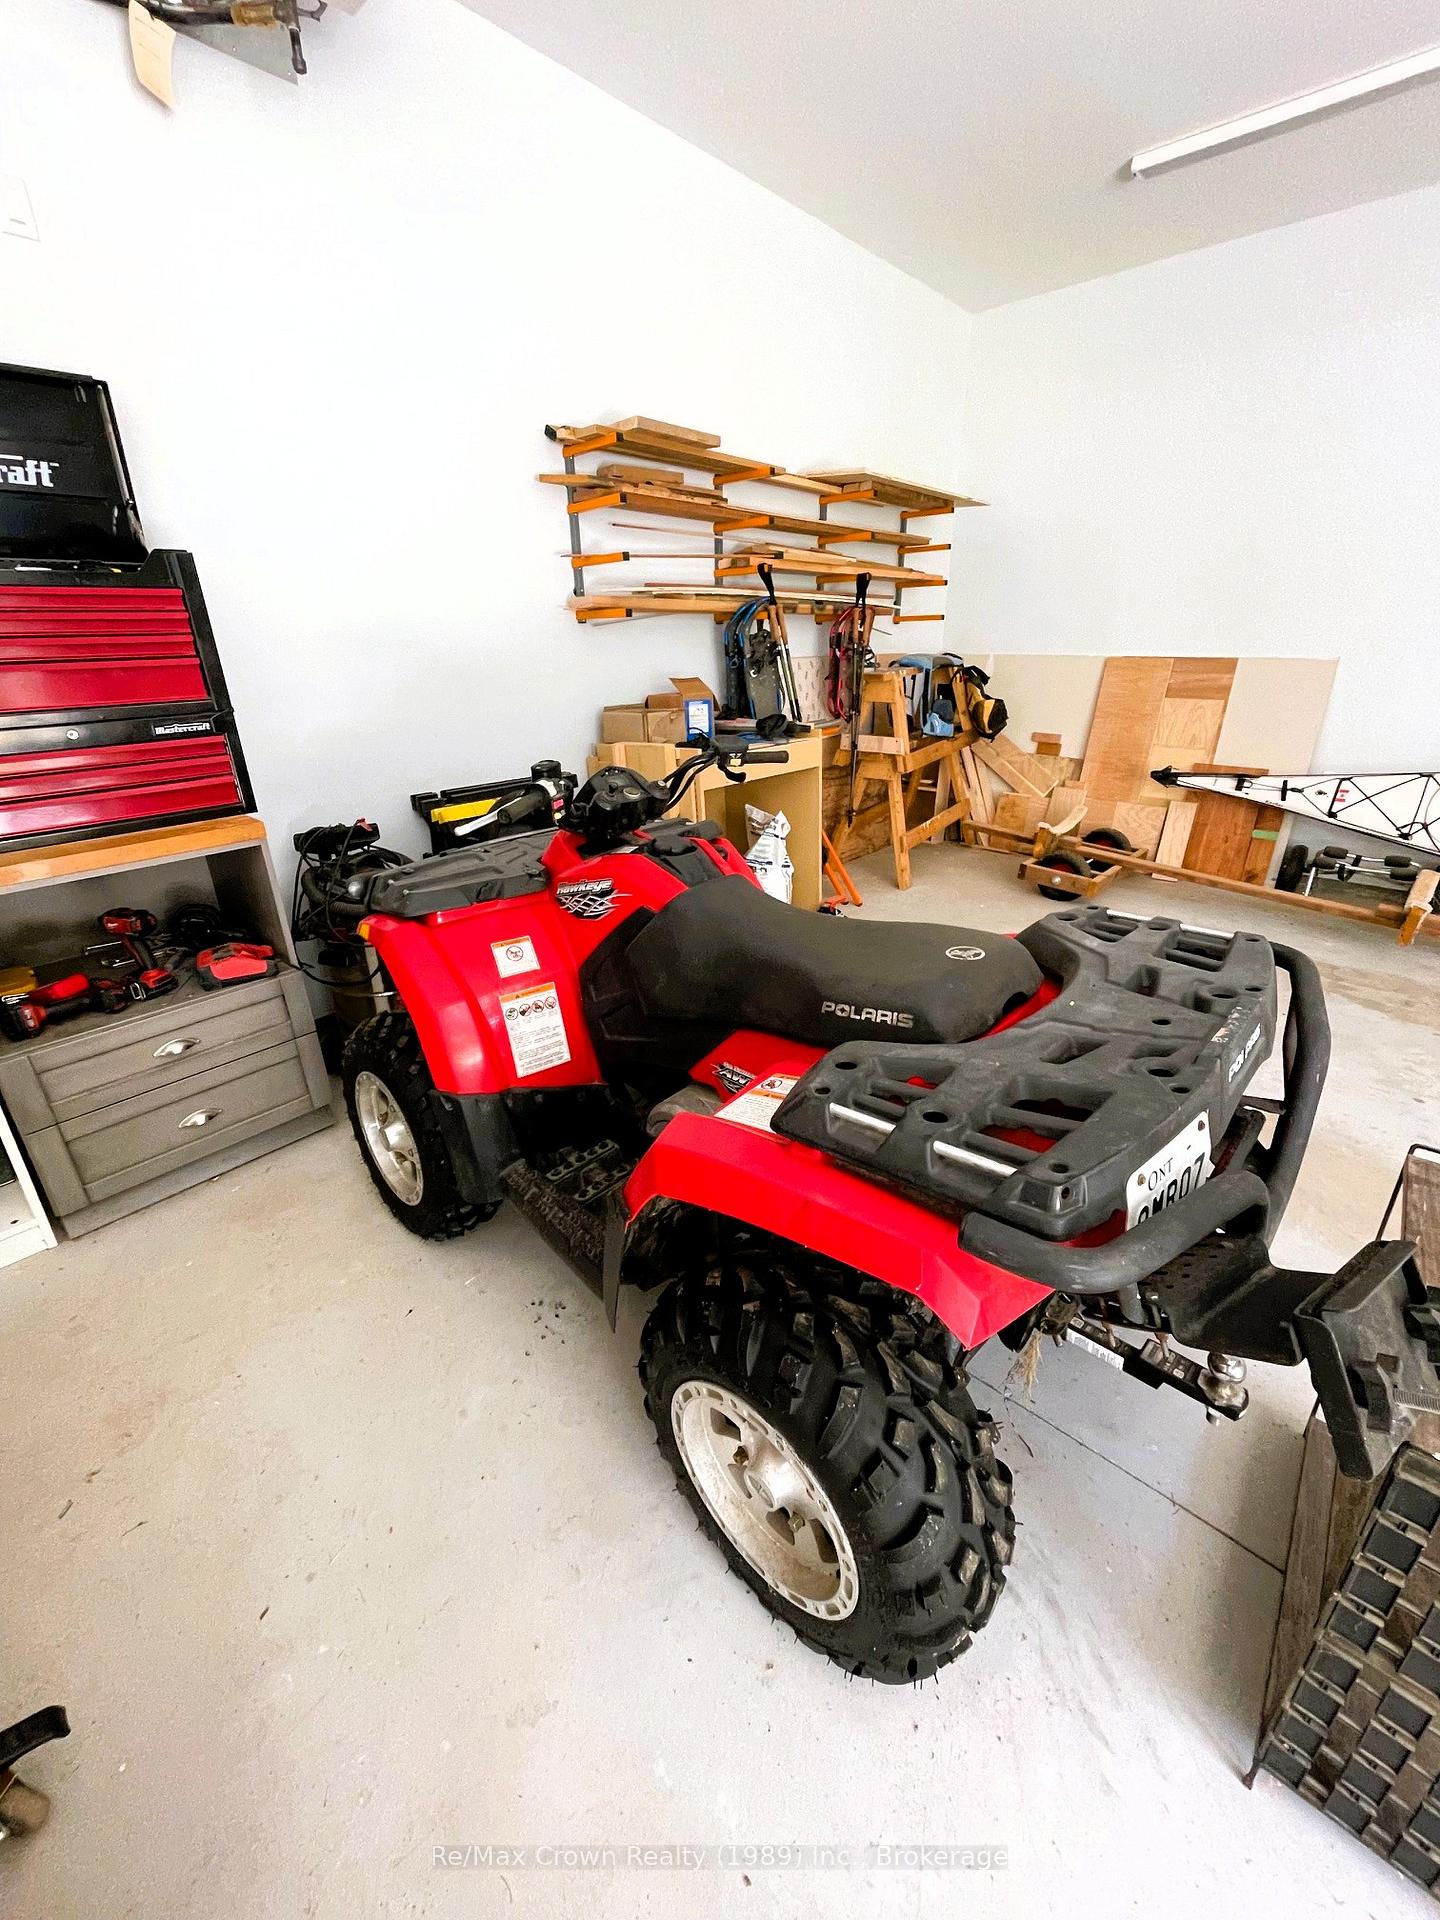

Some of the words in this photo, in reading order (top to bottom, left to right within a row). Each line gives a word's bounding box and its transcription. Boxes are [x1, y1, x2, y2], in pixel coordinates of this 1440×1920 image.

[154, 722, 211, 735] Mastercraft
[821, 1001, 914, 1028] POLARIS
[1148, 1157, 1174, 1191] ONT
